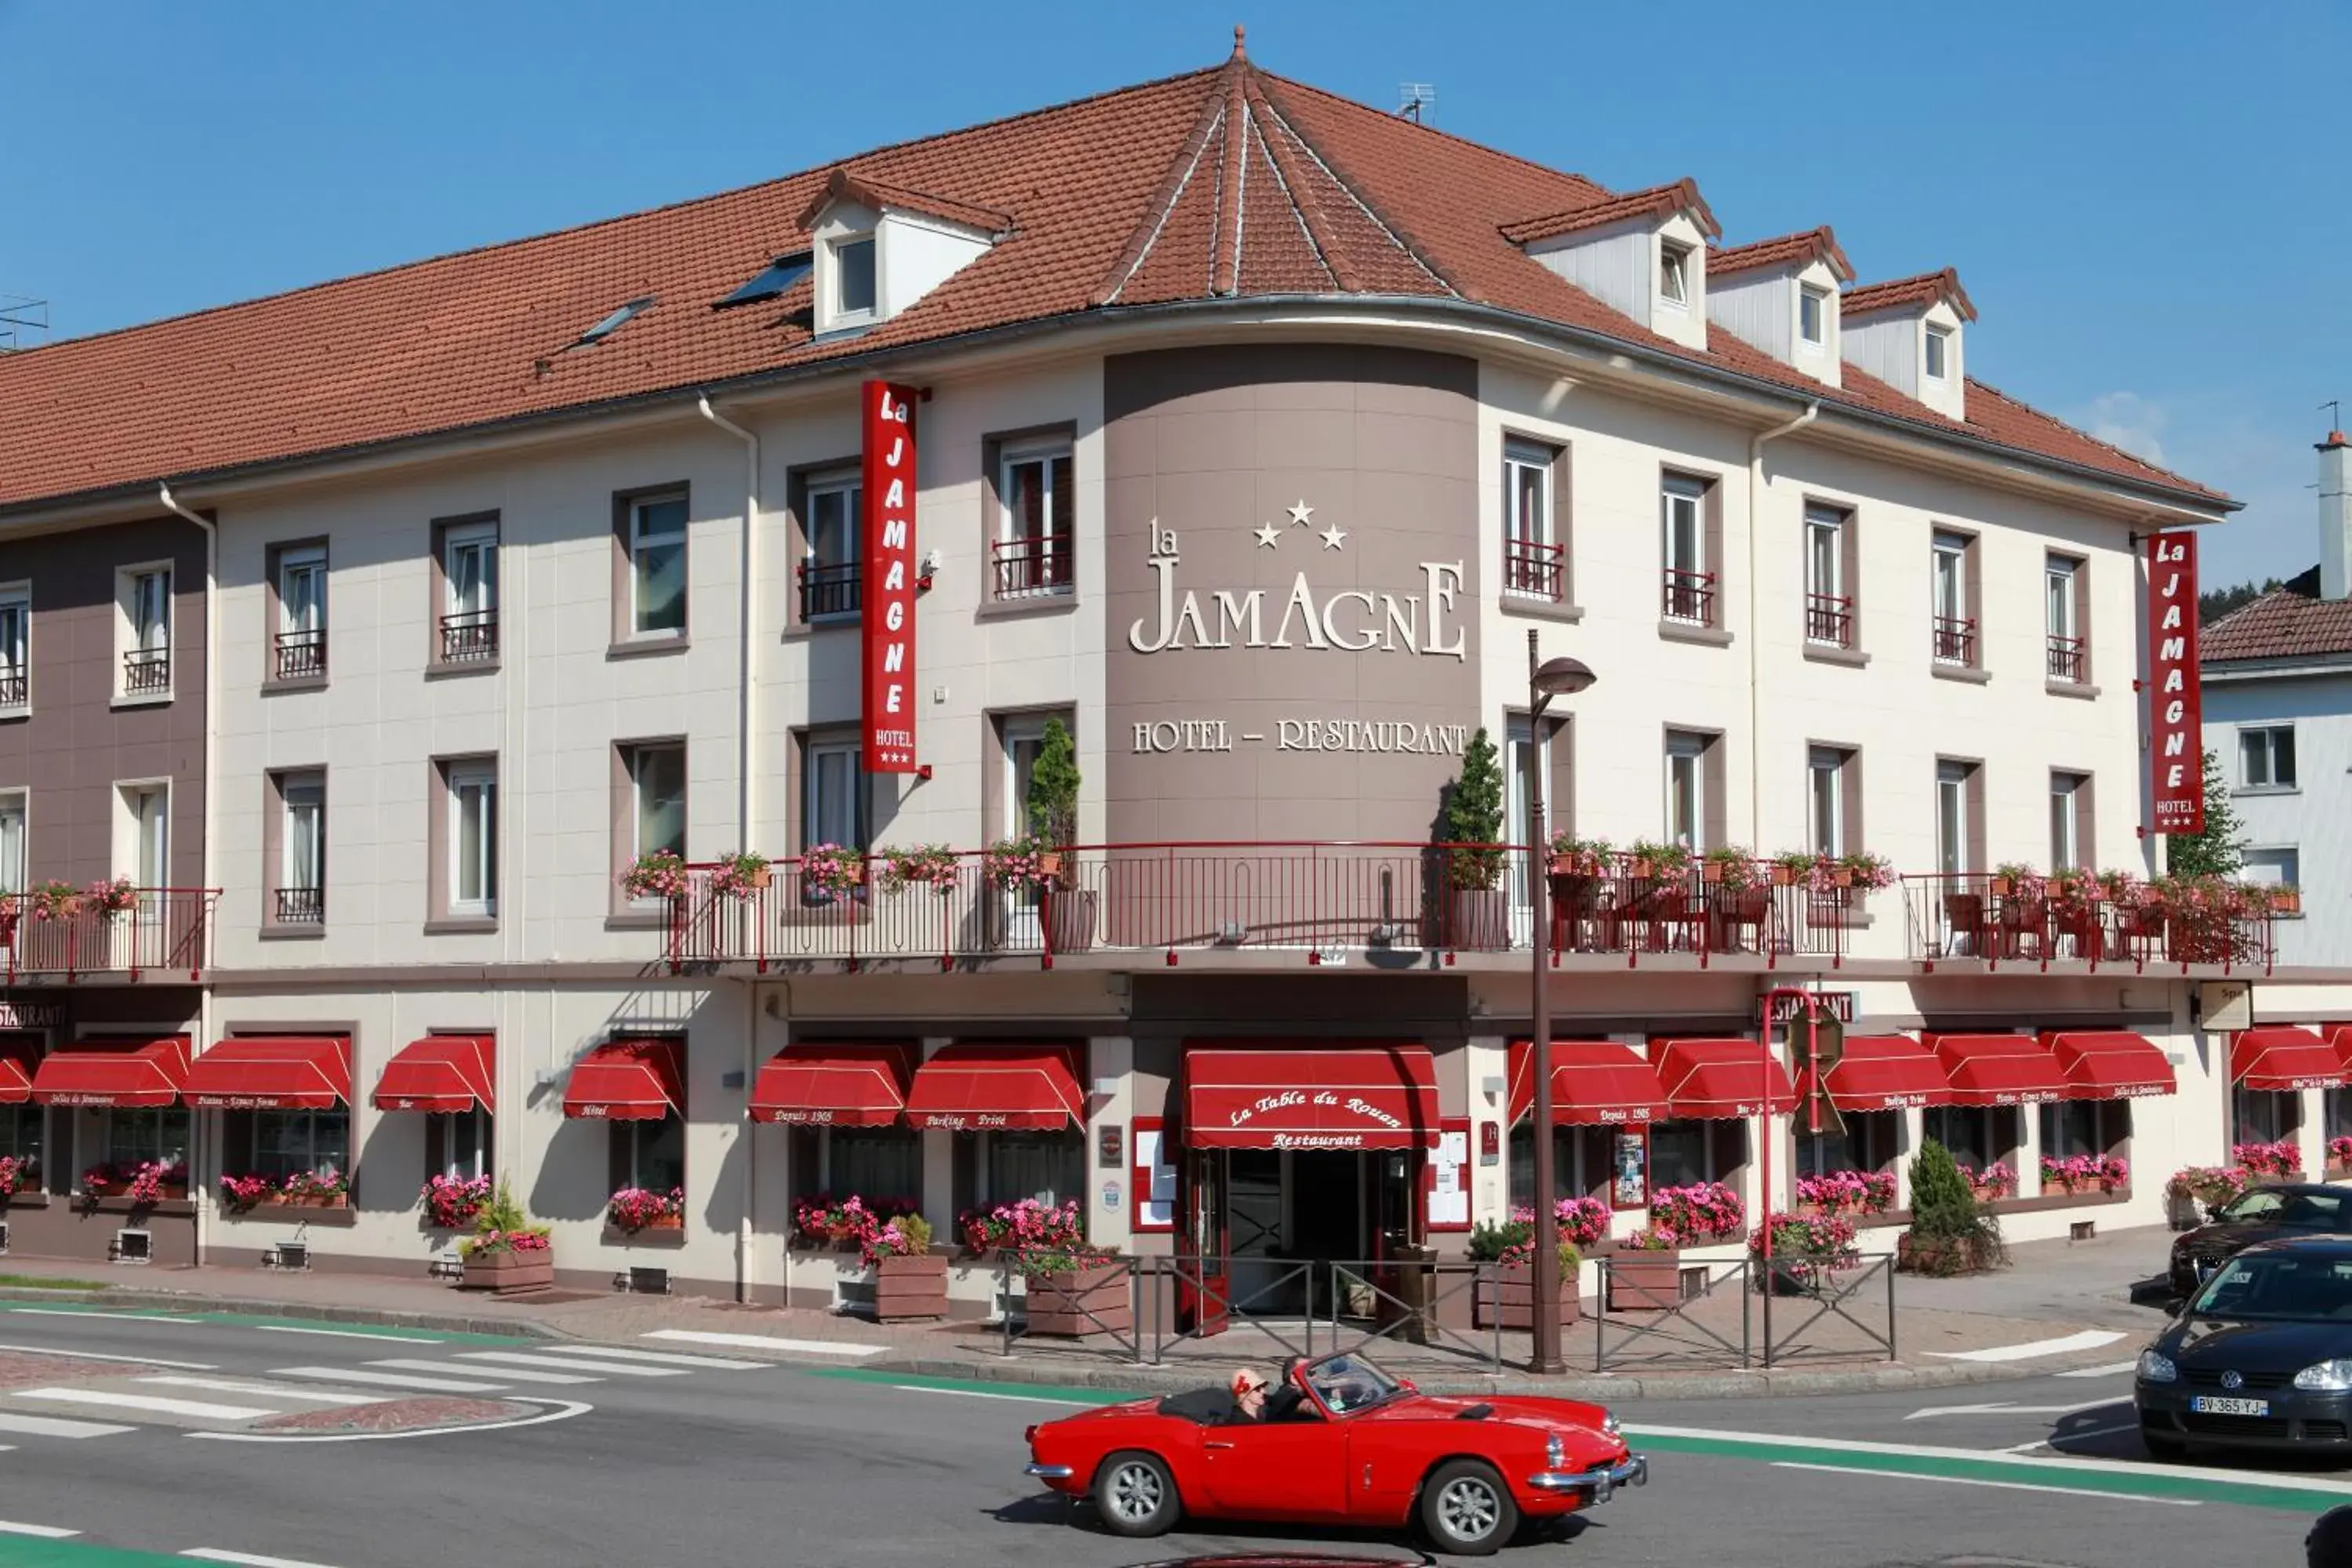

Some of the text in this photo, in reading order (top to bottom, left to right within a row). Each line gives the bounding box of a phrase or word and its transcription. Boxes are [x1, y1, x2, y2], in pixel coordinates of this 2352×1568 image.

[1149, 515, 1178, 557] la
[880, 390, 908, 713] La JAMAGNE
[1128, 556, 1466, 664] JAMAGNE
[2157, 539, 2186, 789] La JAMAGNE
[876, 729, 915, 748] HOTEL
[1131, 719, 1232, 753] HOTEL
[1275, 718, 1467, 757] RESTAURANT
[2157, 800, 2196, 814] HOTEL
[775, 1109, 807, 1123] Depuis
[1230, 1091, 1403, 1129] La Table du Rouan
[1600, 1109, 1627, 1122] Depuis
[926, 1113, 1007, 1131] Parking Privé
[1271, 1132, 1363, 1149] Restaurant
[1489, 1127, 1497, 1140] H
